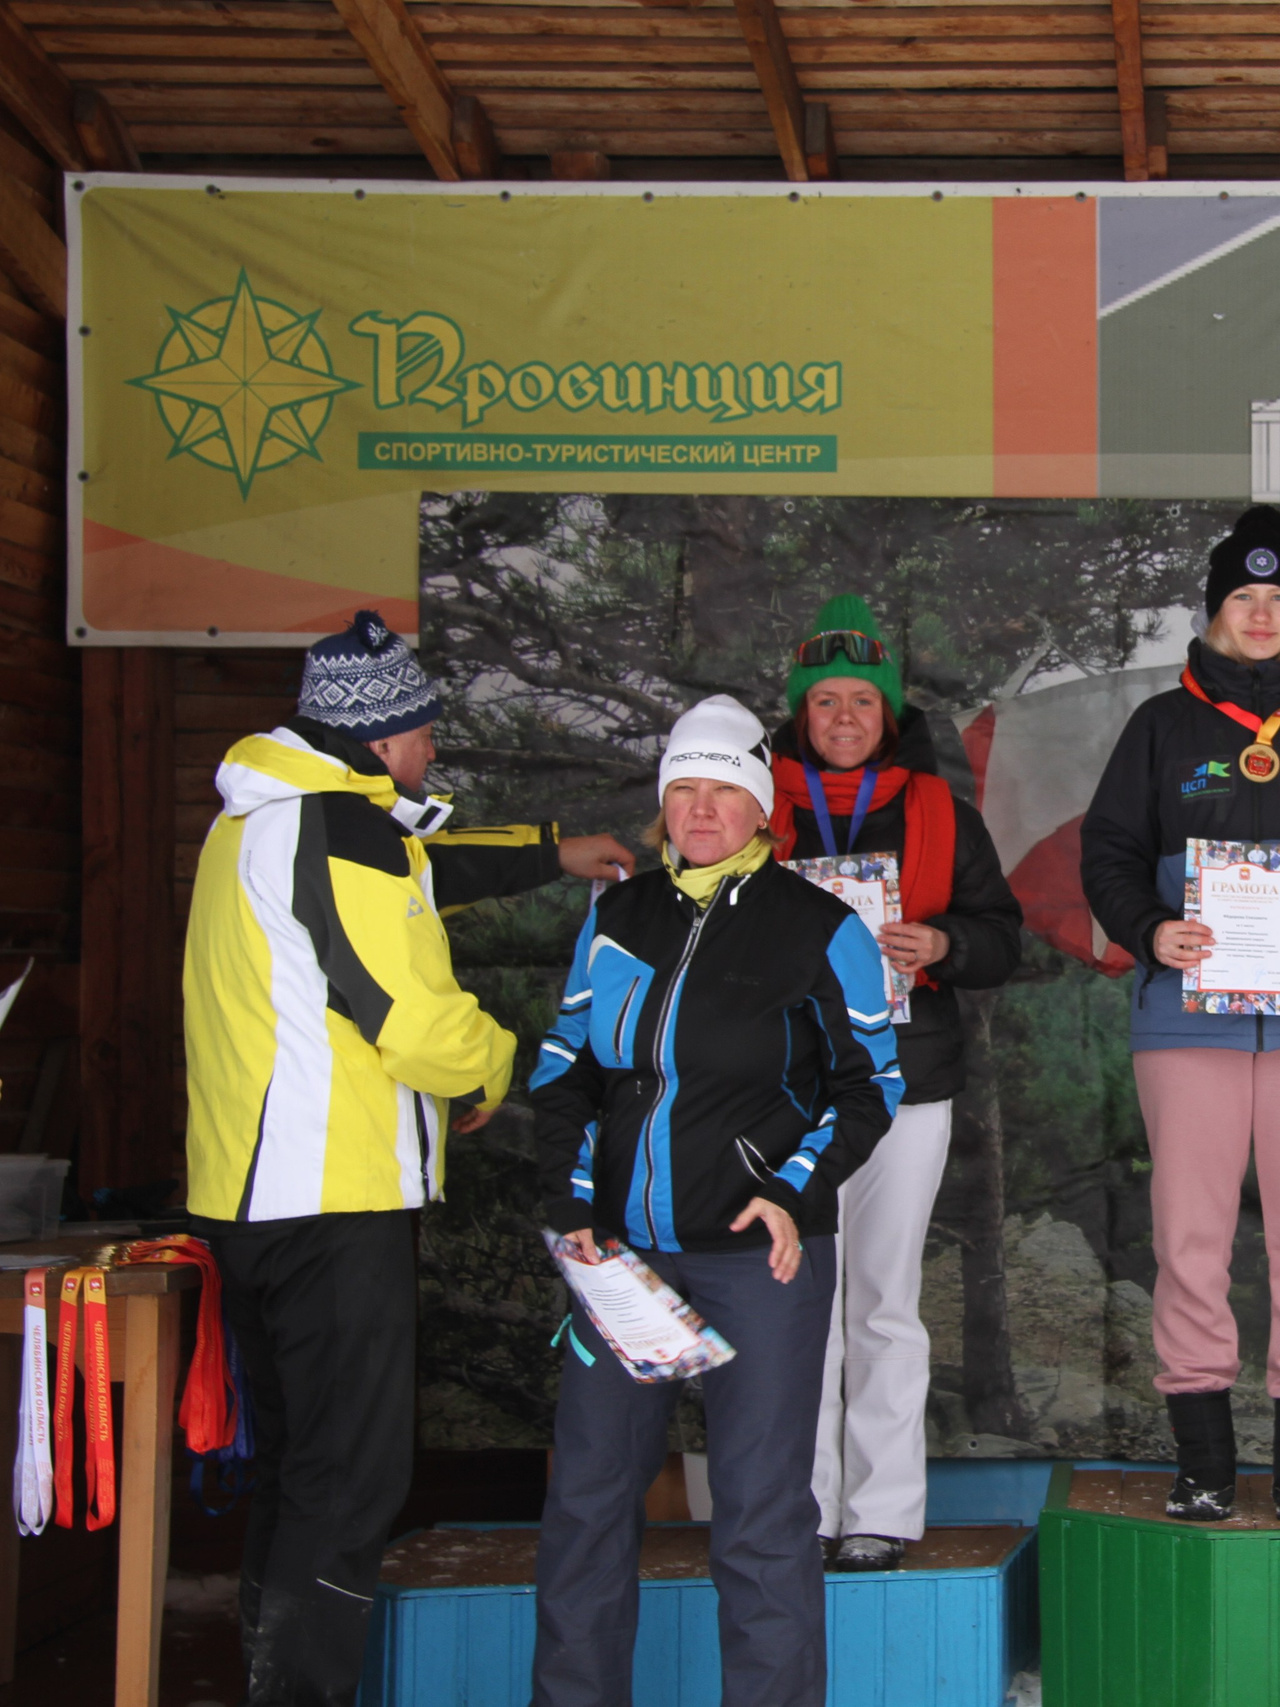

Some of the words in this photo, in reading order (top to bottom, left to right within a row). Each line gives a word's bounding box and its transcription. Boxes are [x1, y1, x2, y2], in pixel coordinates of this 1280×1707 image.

[348, 310, 842, 429] Провинция
[374, 440, 736, 466] СПОРТИВНО-ТУРИСТИЧЕСКИЙ
[743, 443, 822, 467] ЦЕНТР
[669, 751, 732, 766] FISCHER
[1211, 881, 1279, 895] ГРАМОТА
[34, 1398, 45, 1444] ОБЛАСТЬ
[97, 1394, 109, 1442] ОБЛАСТЬ
